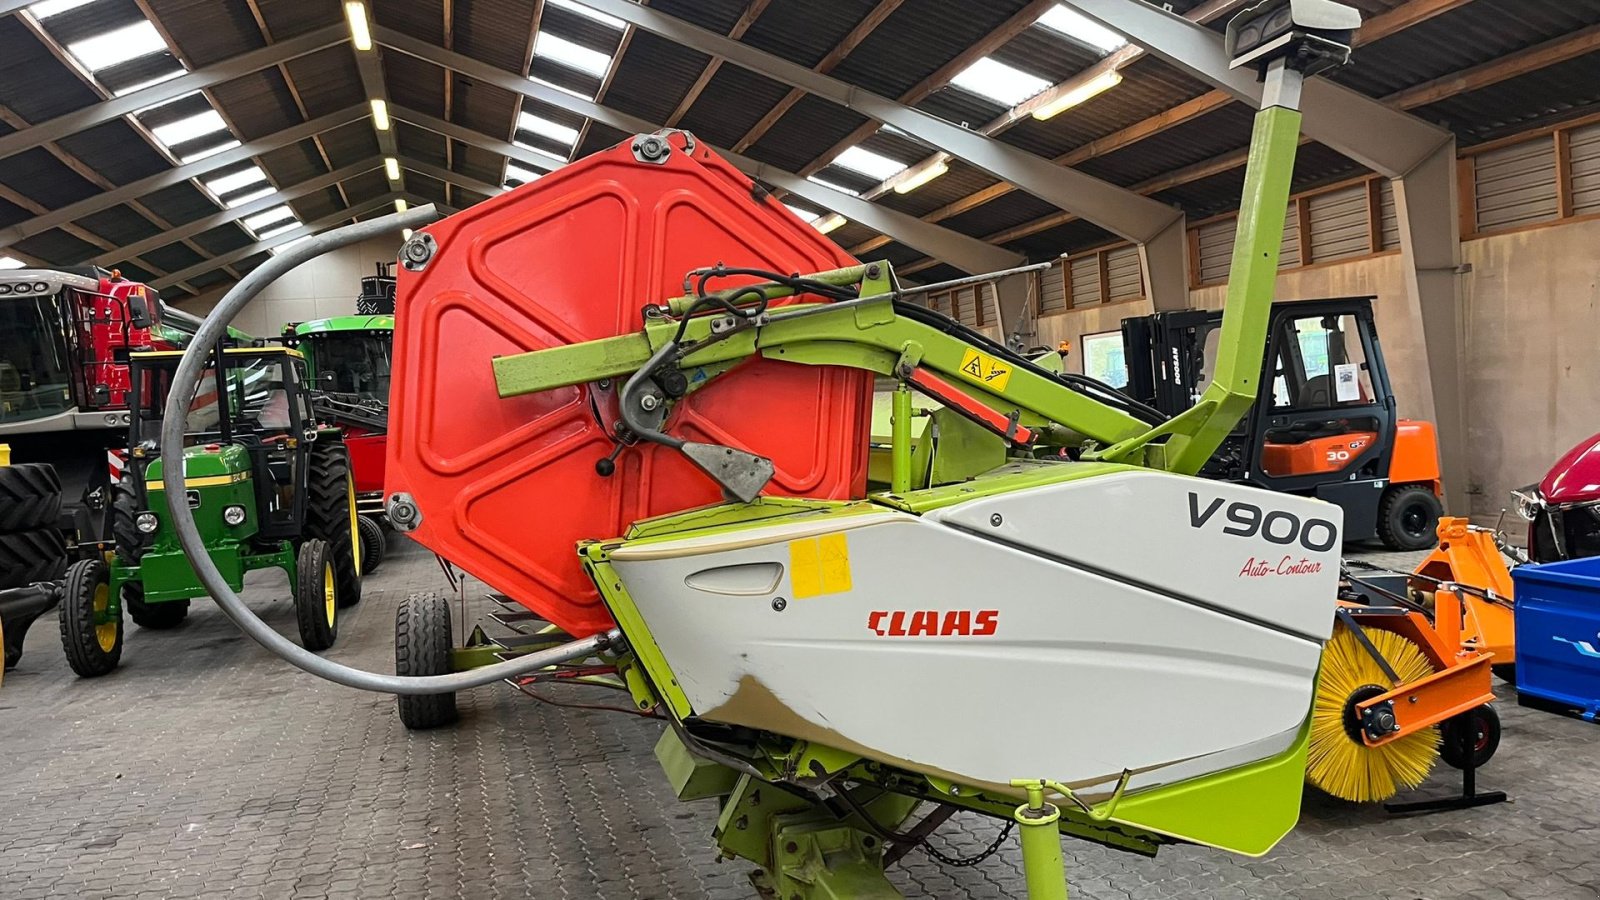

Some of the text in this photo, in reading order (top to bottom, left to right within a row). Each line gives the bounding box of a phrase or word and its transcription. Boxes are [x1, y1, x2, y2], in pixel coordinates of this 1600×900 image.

[1326, 451, 1349, 461] 30
[1188, 492, 1338, 552] V900
[1239, 555, 1322, 577] Auto-Contour
[867, 610, 999, 636] CLAAS
